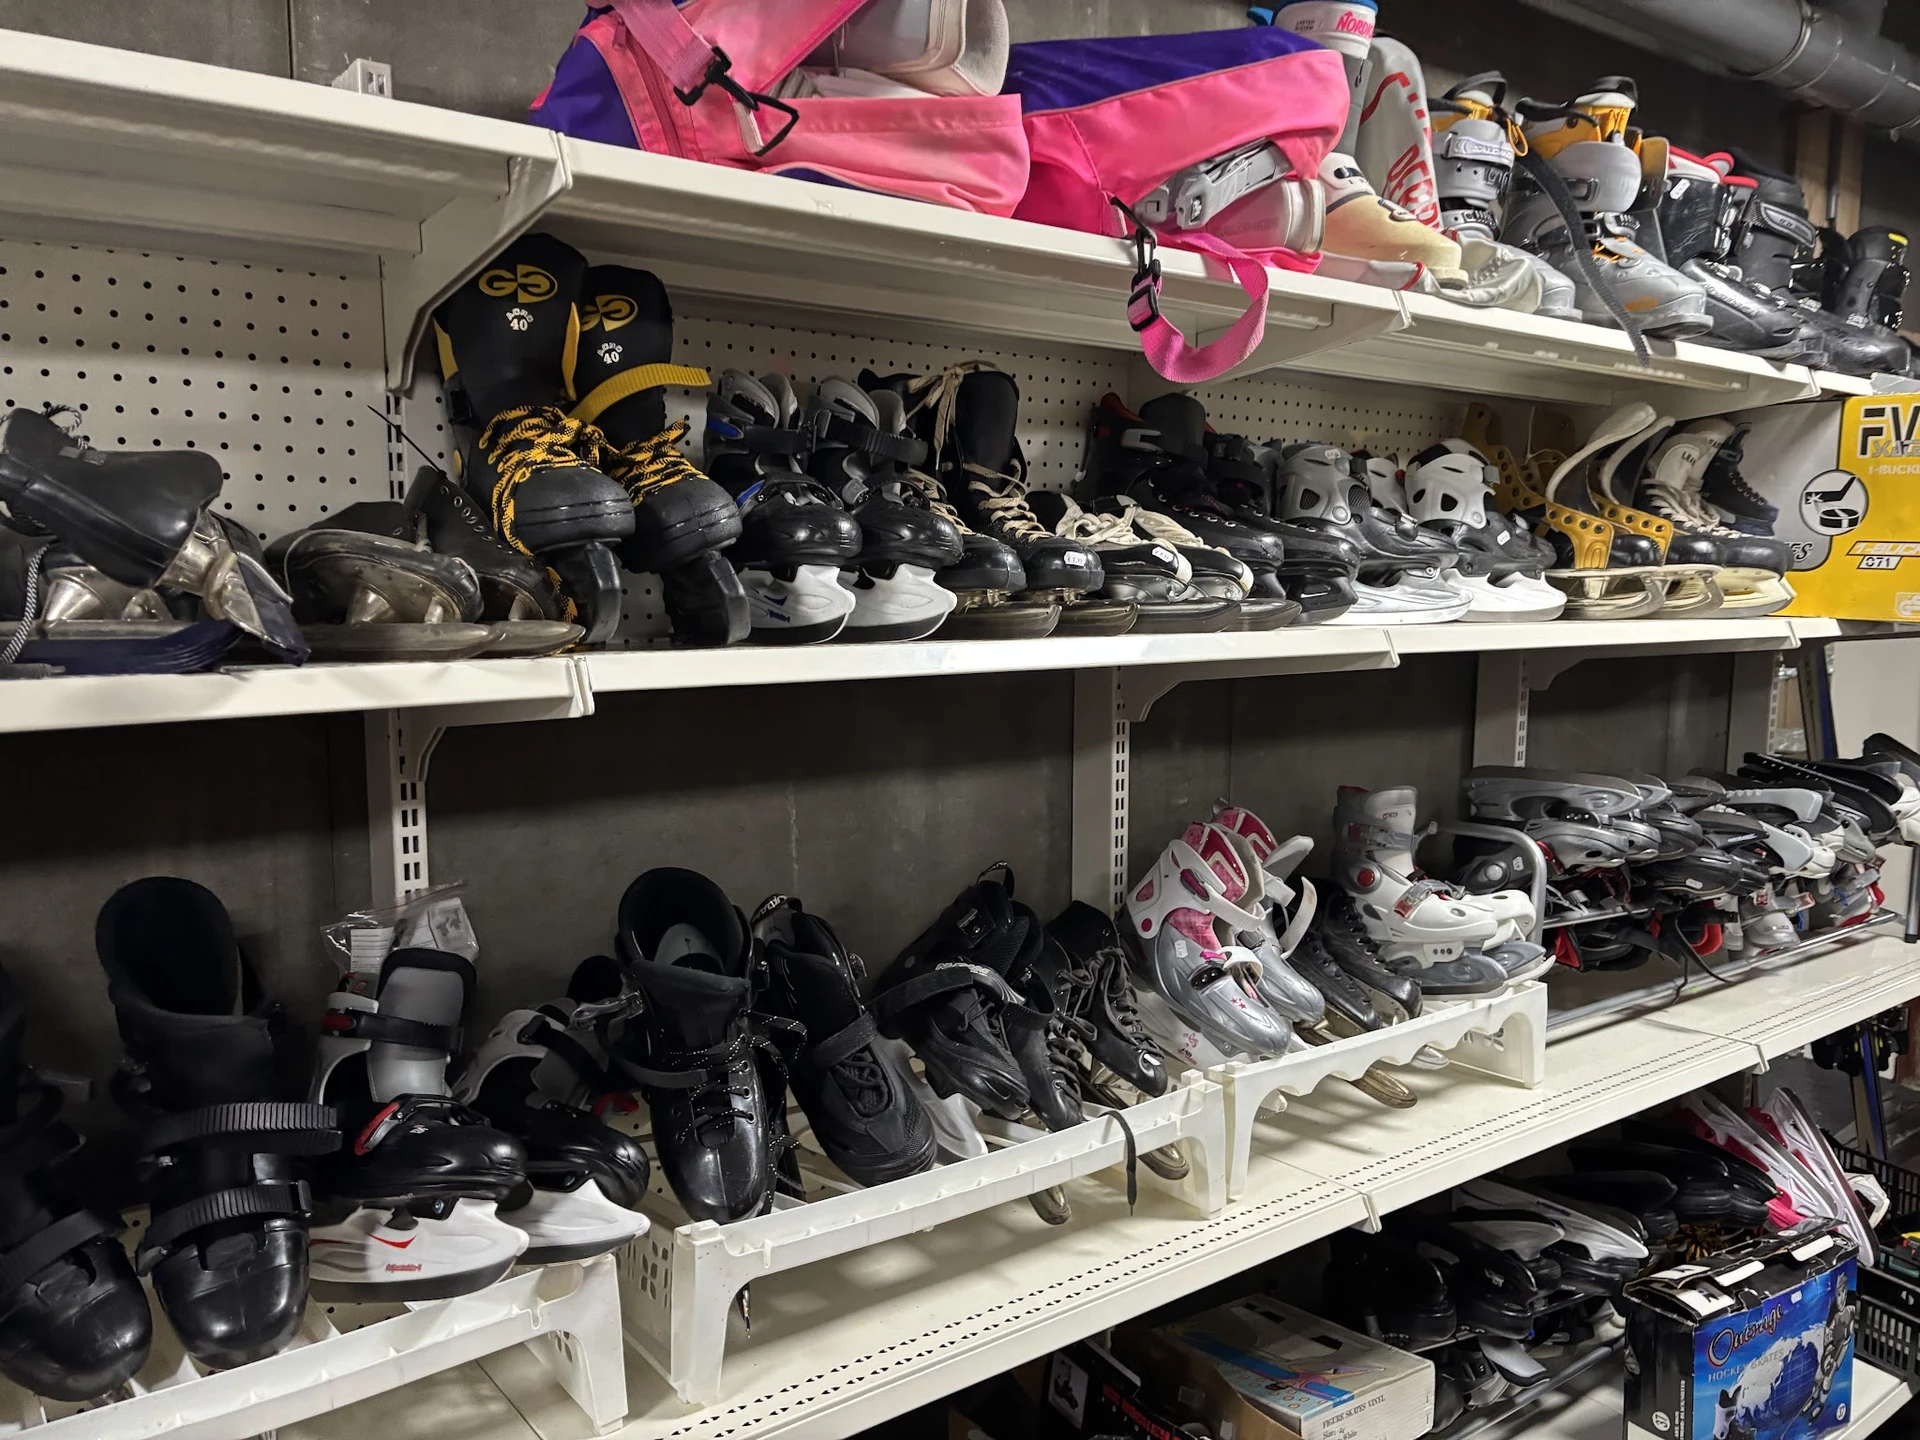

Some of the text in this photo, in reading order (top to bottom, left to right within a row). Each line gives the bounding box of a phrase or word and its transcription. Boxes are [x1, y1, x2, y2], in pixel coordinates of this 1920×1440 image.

[510, 318, 528, 331] 40
[603, 351, 620, 365] 40
[1865, 556, 1890, 568] 071
[1708, 1347, 1785, 1383] HOCKEY SKATES
[1322, 1395, 1386, 1429] FIGURE SKATES VINYL
[1655, 1413, 1668, 1428] 37
